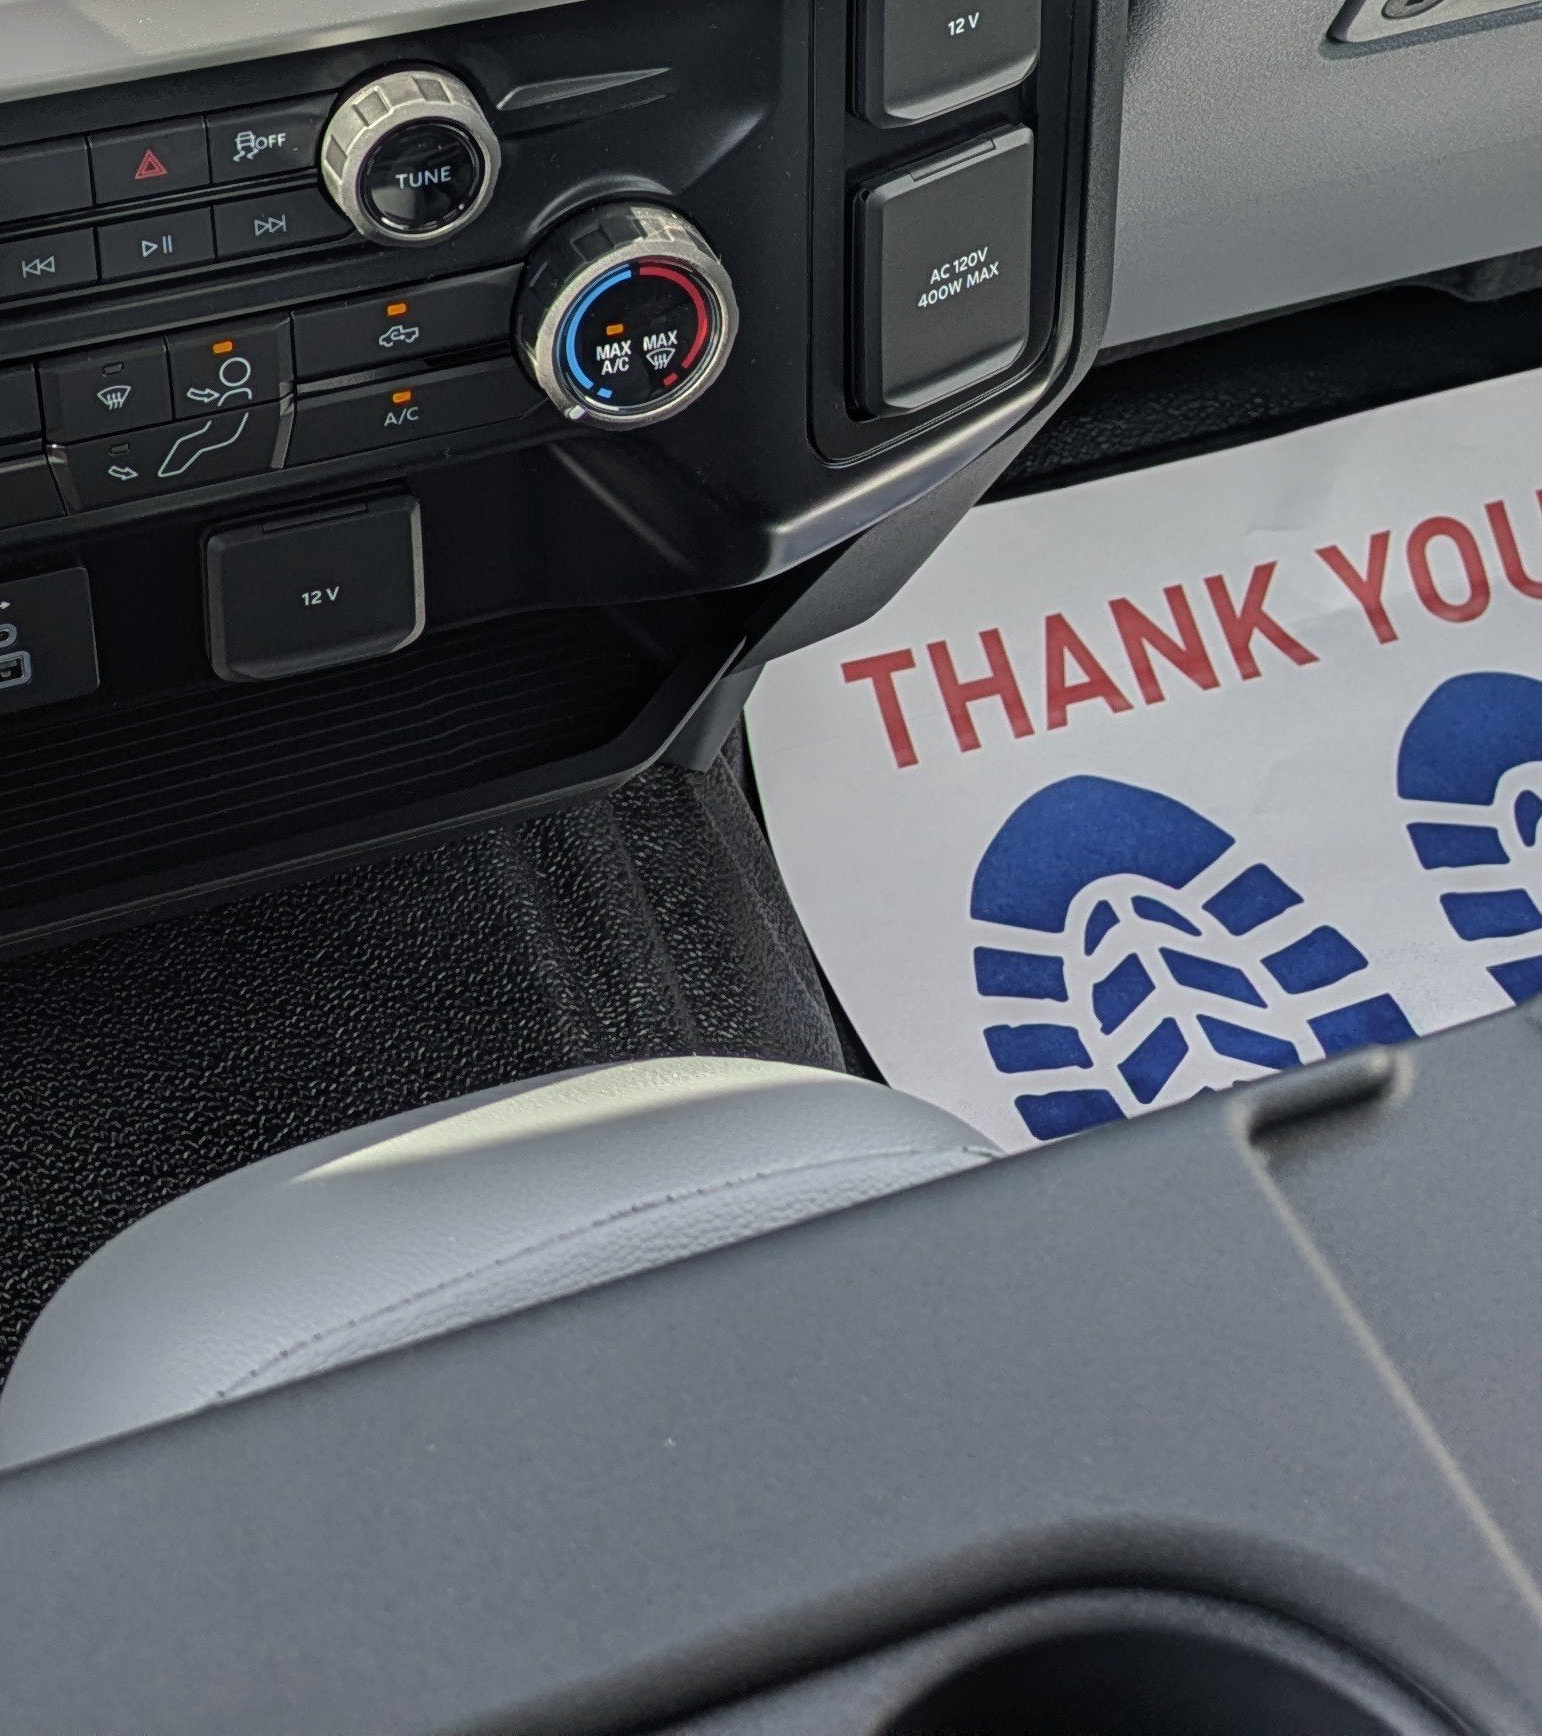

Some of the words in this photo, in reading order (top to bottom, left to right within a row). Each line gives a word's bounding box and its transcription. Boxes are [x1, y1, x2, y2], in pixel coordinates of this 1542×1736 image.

[948, 16, 965, 36] 12
[966, 12, 980, 32] V
[257, 131, 286, 151] OFF
[394, 166, 453, 190] TUNE
[929, 264, 952, 285] AC
[952, 246, 989, 276] 120V
[917, 281, 963, 310] 400W
[965, 262, 1000, 290] MAX
[596, 339, 633, 360] MAX
[643, 329, 679, 350] MAX
[601, 355, 631, 375] A/C
[383, 405, 420, 428] A/C
[302, 587, 319, 606] 12
[321, 584, 340, 604] V
[841, 559, 1320, 769] THANK
